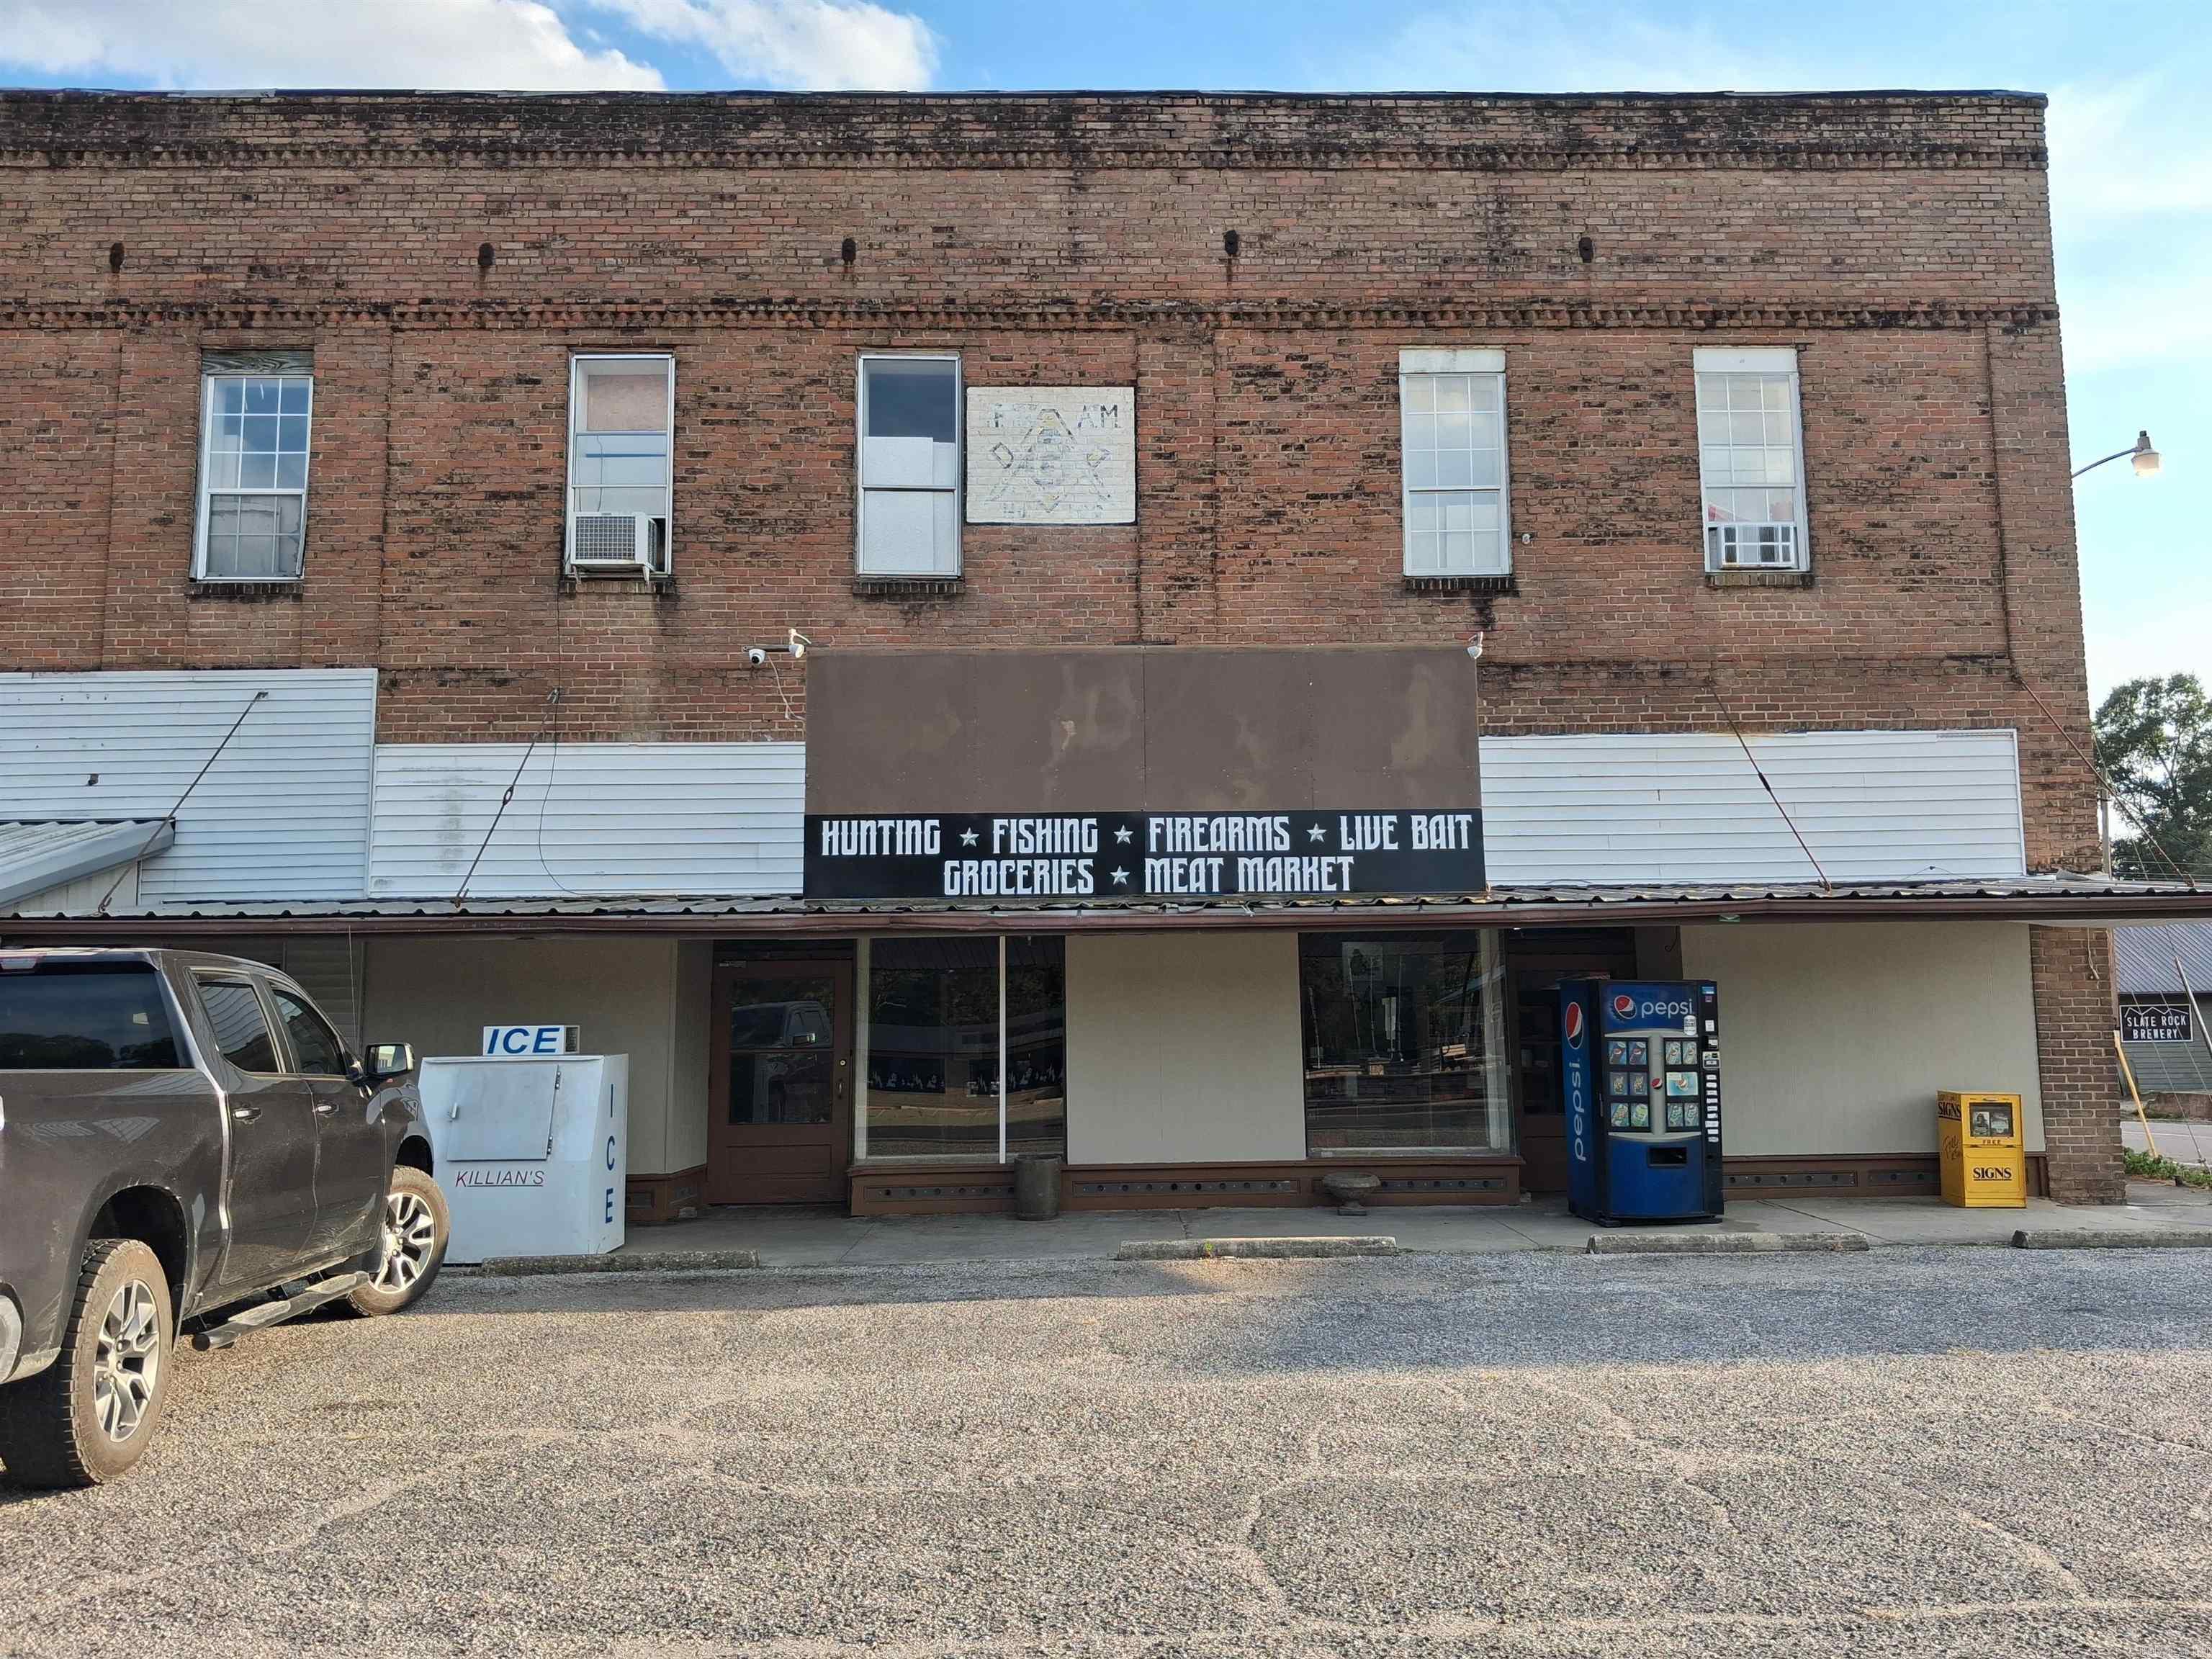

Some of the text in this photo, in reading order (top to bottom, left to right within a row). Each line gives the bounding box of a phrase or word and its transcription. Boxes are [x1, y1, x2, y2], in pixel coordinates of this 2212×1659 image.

[822, 819, 940, 856] HUNTING
[992, 818, 1098, 854] FISHING
[1149, 816, 1290, 853] FIREARMS
[1340, 814, 1473, 850] LIVE BAIT
[944, 858, 1094, 896] GROCERIES
[1145, 855, 1354, 894] MEAT MARKET
[1641, 998, 1693, 1019] pepsi
[2127, 1015, 2187, 1027] SLATE ROCK
[487, 1028, 560, 1054] ICE
[2132, 1028, 2178, 1040] BREWERY
[1569, 1061, 1587, 1162] pepsi
[1938, 1101, 1961, 1118] SIGNS
[455, 1170, 544, 1187] KILLIAN'S
[1973, 1167, 2012, 1179] SIGNS
